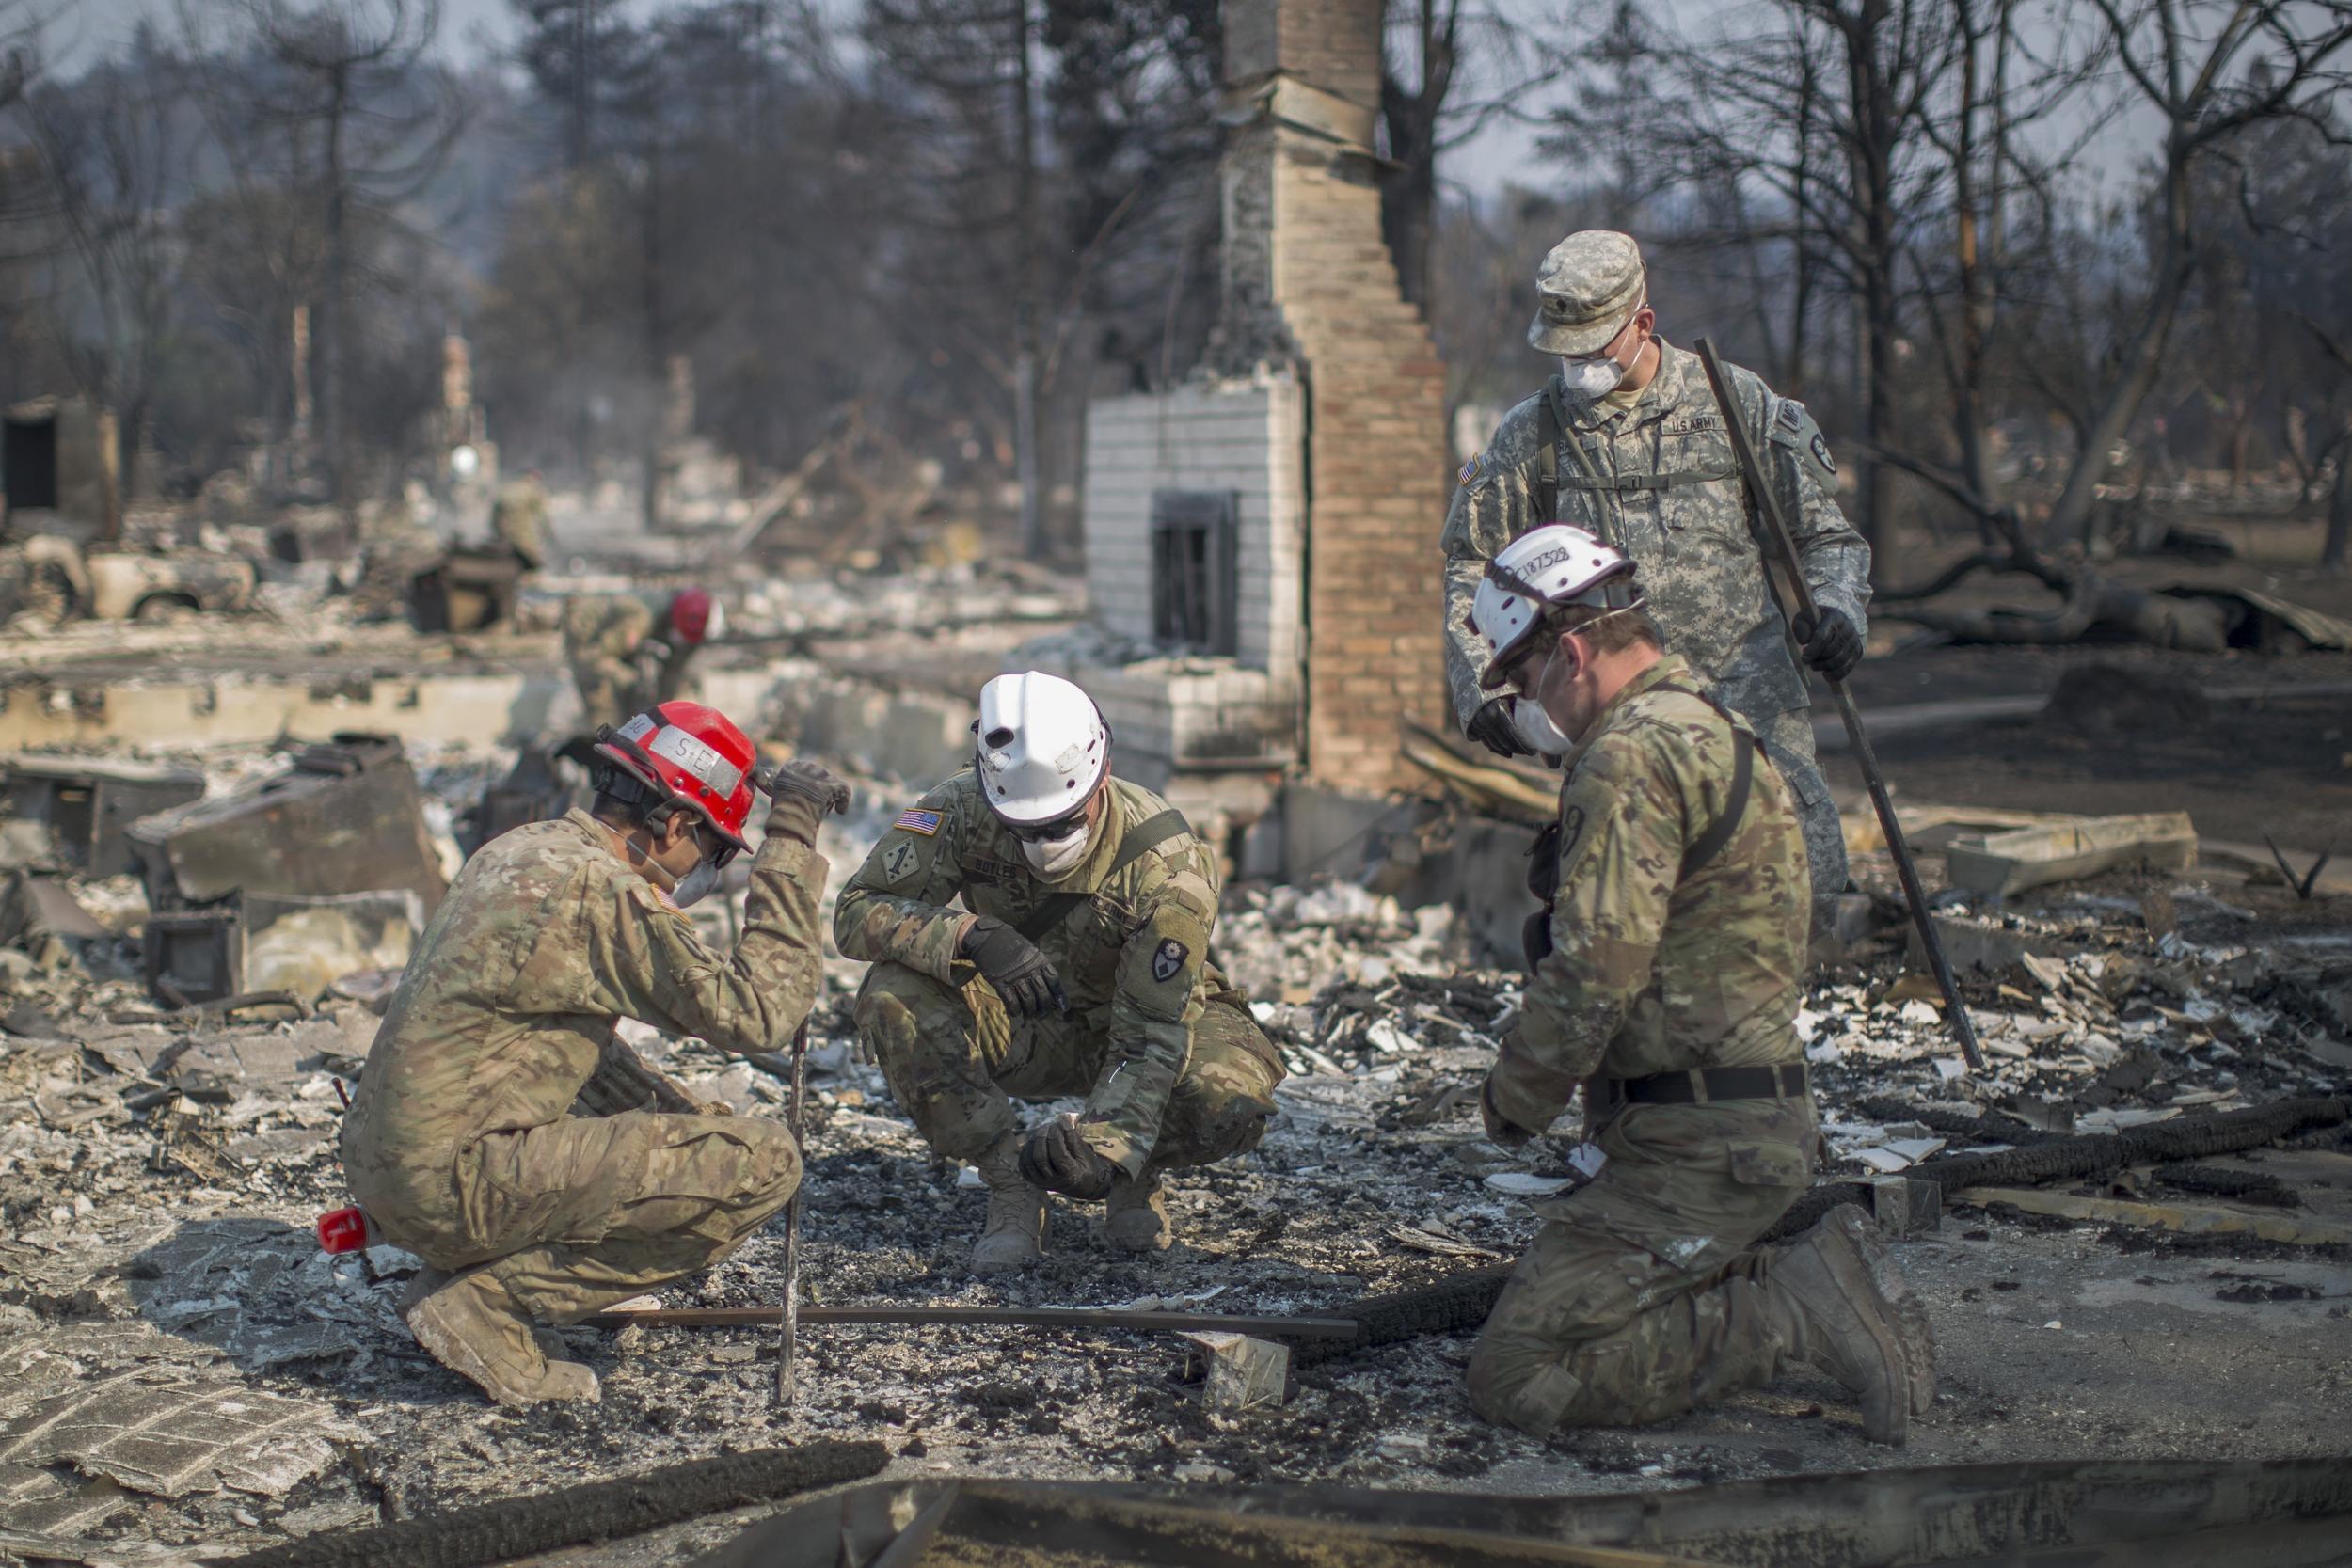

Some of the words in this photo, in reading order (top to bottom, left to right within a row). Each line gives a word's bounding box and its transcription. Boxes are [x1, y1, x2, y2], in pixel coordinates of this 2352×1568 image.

[1673, 421, 1690, 433] U.S.
[1690, 417, 1716, 430] ARMY
[1782, 404, 1799, 427] MP
